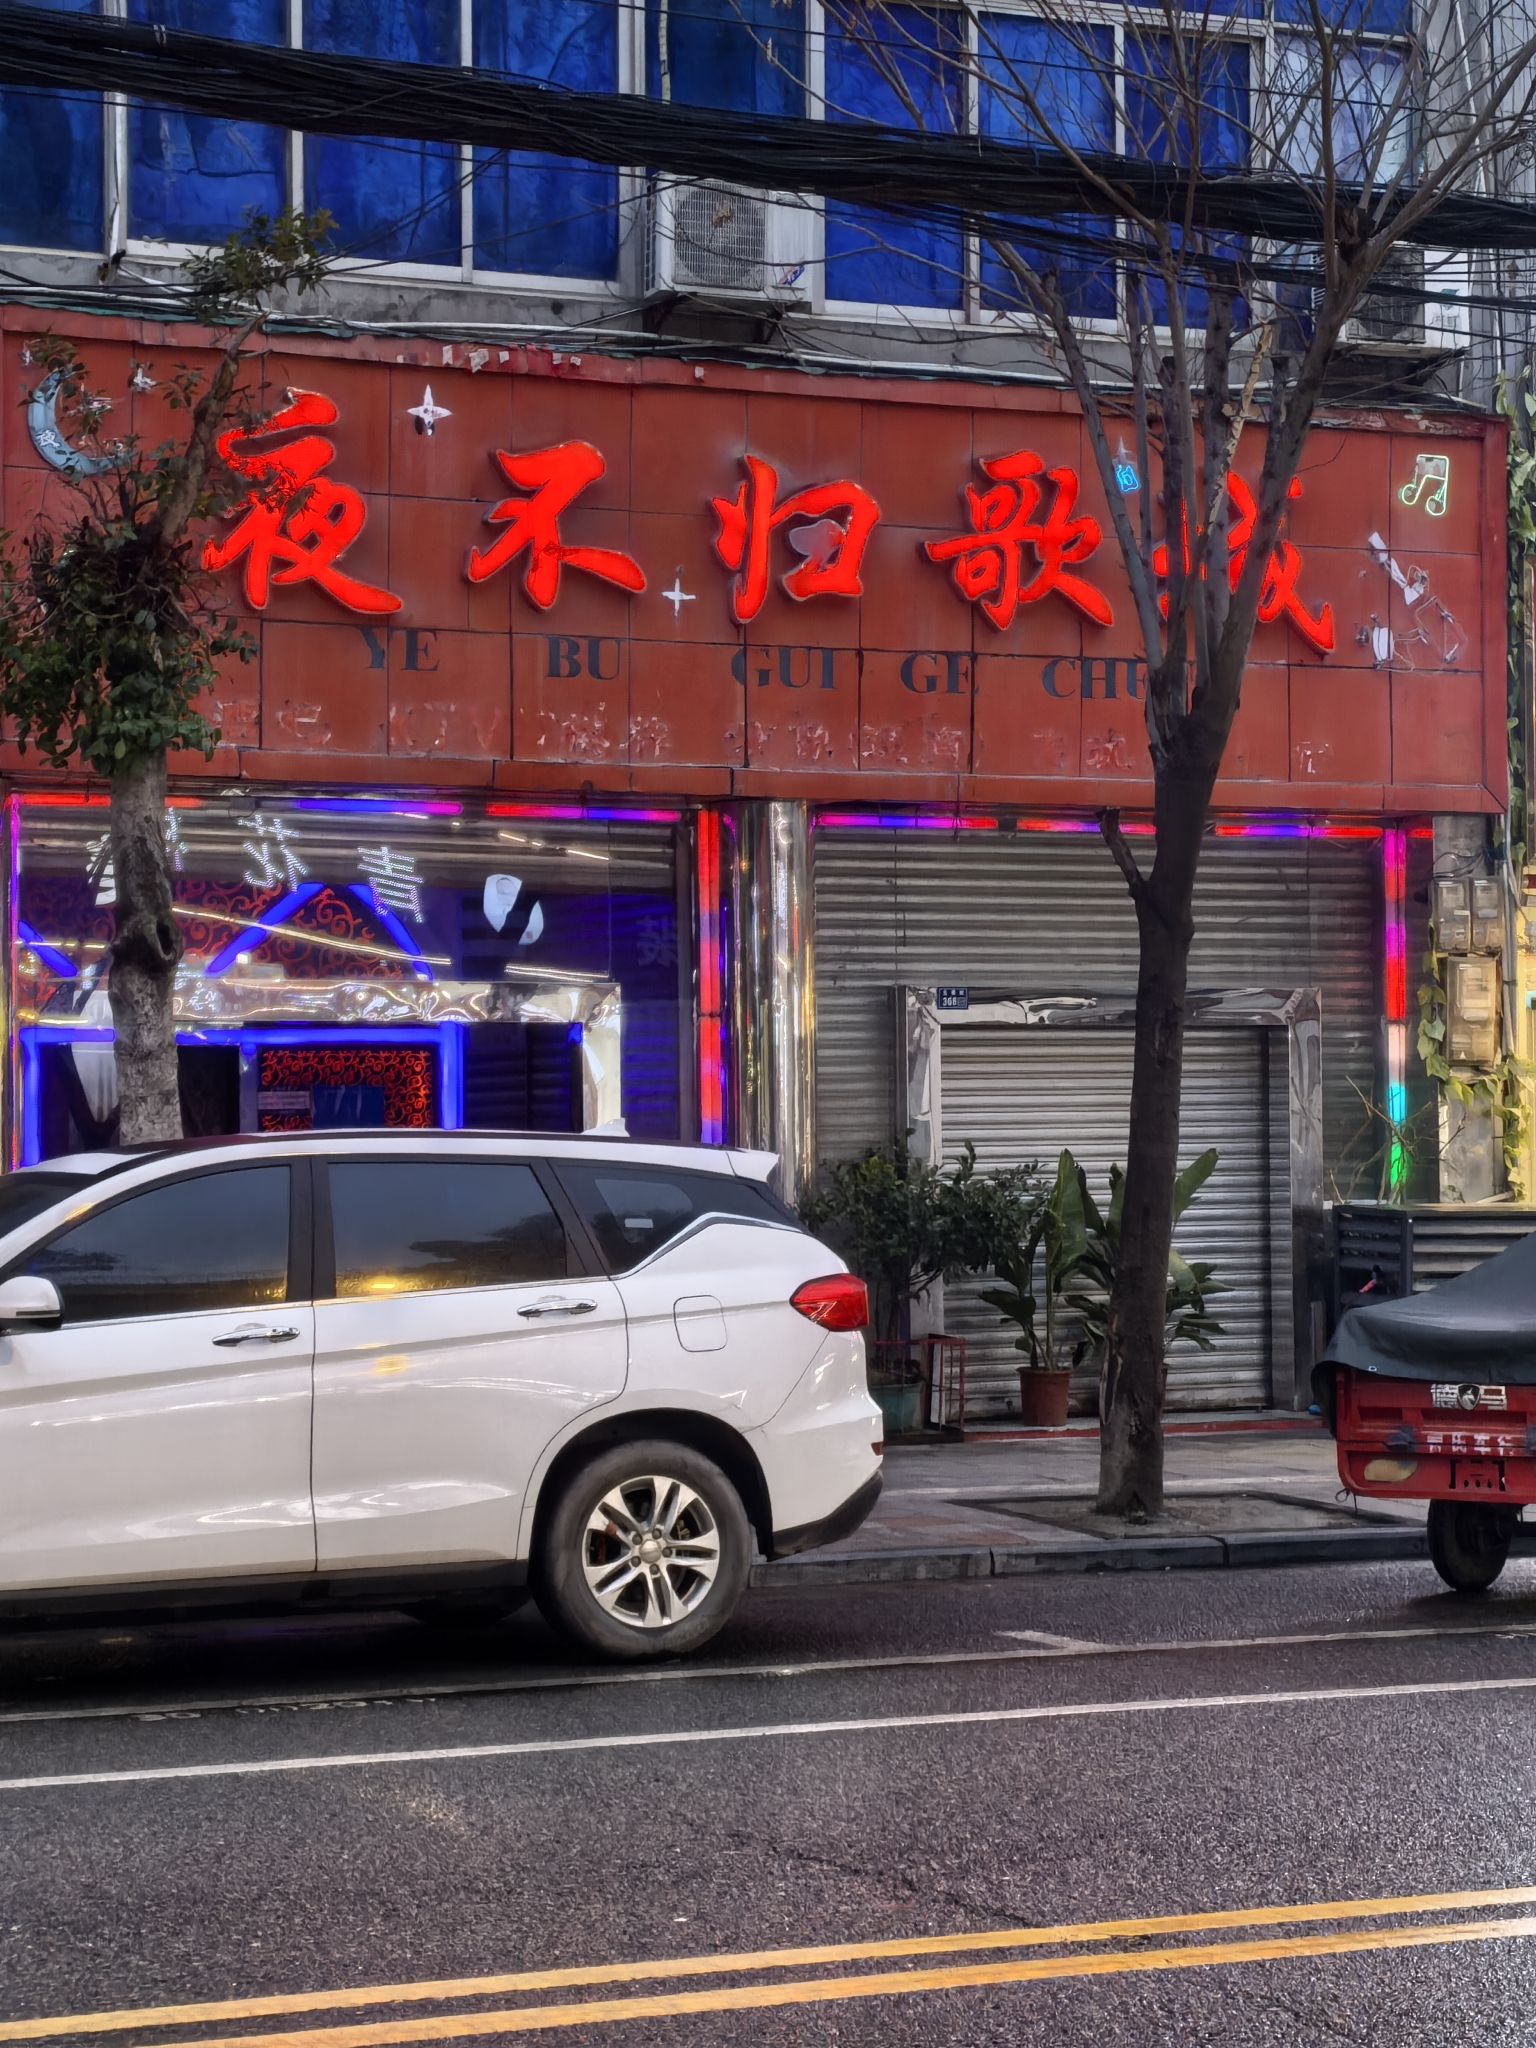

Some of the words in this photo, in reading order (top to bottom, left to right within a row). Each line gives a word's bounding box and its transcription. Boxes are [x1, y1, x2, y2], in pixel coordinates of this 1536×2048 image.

[356, 627, 440, 672] YE
[543, 635, 622, 681] BU
[730, 646, 838, 690] GUI
[900, 652, 980, 694] GE
